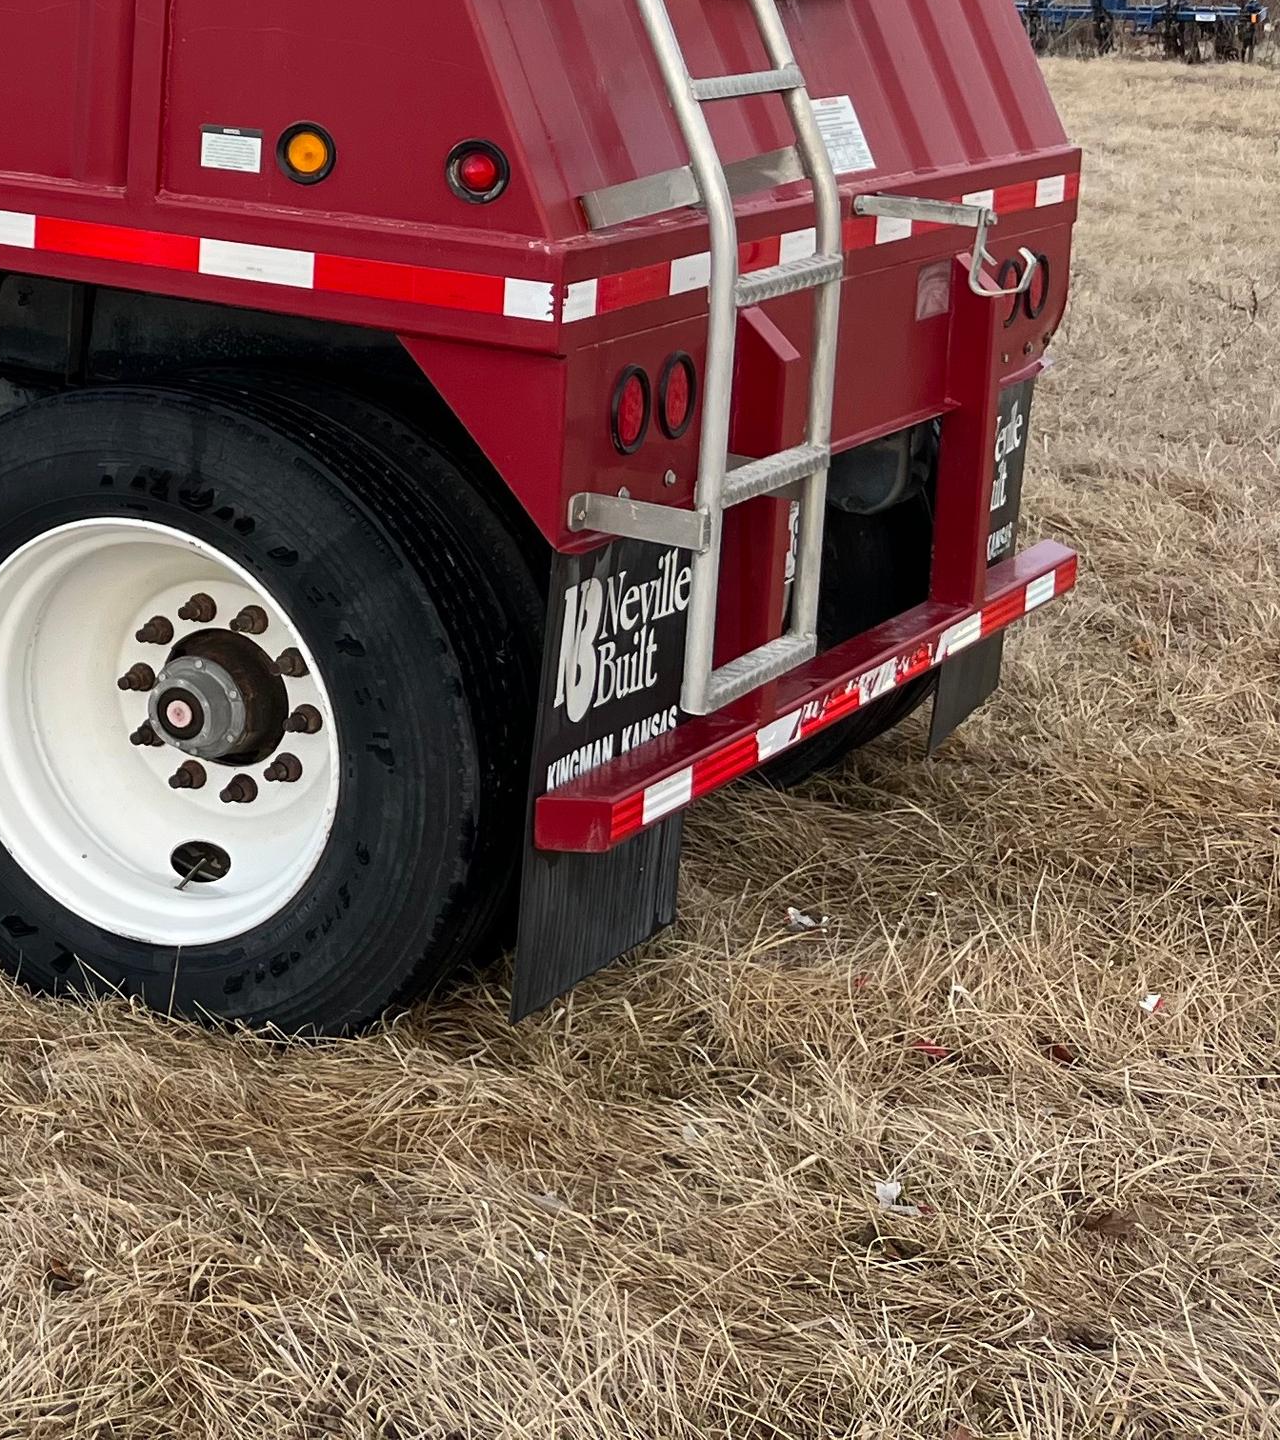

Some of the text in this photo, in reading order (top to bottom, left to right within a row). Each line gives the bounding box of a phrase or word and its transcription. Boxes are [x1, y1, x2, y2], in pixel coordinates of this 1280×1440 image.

[599, 546, 691, 641] Neville
[592, 624, 658, 708] Built
[546, 704, 678, 792] KINGMAN KANSAS
